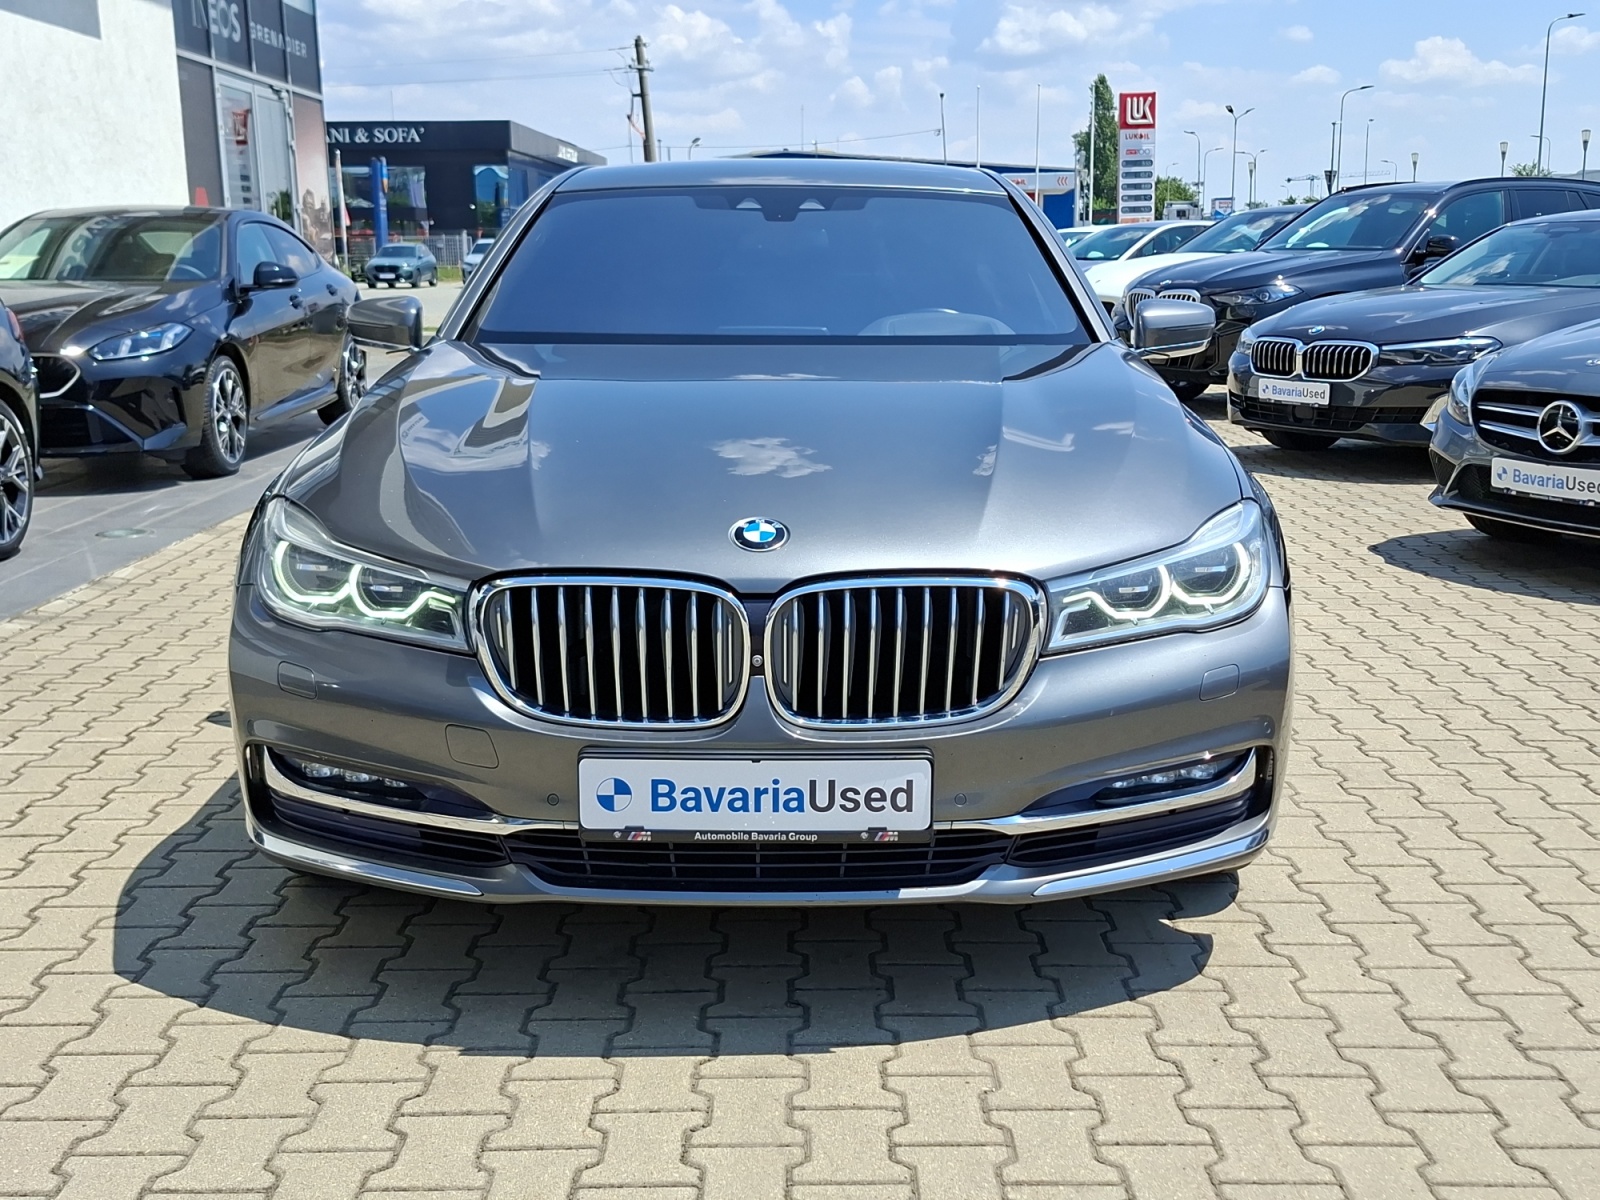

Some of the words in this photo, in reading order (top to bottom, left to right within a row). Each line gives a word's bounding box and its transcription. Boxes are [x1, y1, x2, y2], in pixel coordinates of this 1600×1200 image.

[249, 21, 308, 58] GRENADIER
[354, 127, 370, 143] &
[1271, 384, 1326, 400] BavariaUsed
[1512, 468, 1600, 494] BavariaUse
[651, 778, 914, 813] BavariaUsed
[694, 832, 749, 841] Automobile
[751, 832, 786, 841] Bavaria
[788, 832, 818, 842] Group
